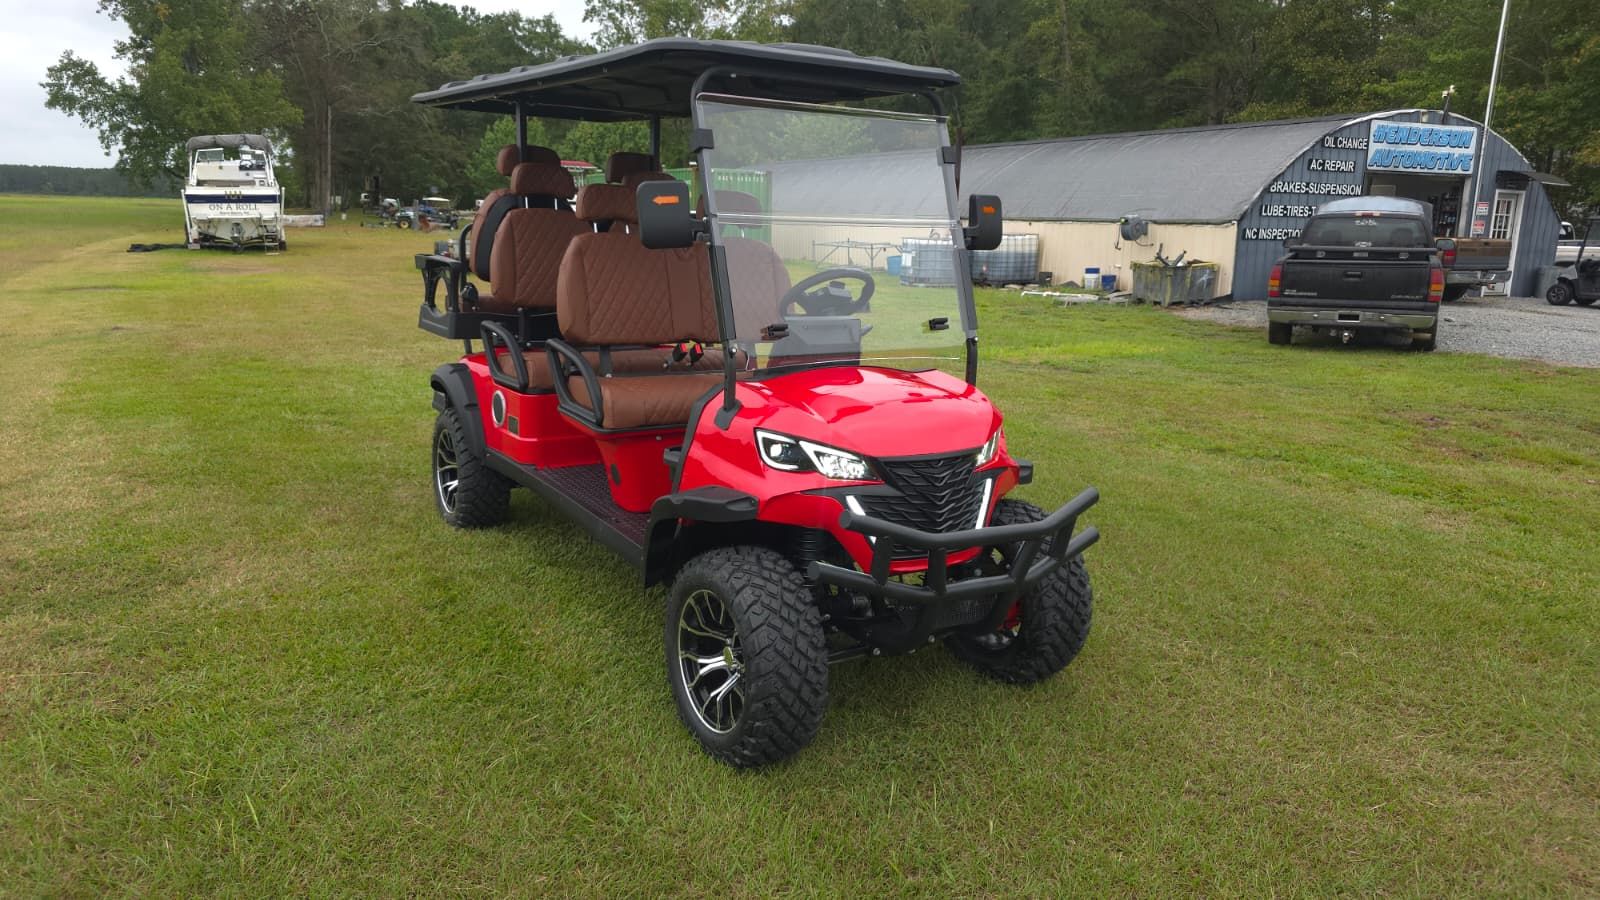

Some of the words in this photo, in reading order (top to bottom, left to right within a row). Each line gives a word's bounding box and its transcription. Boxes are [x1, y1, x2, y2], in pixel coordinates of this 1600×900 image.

[1324, 136, 1336, 148] OIL
[1337, 137, 1368, 150] CHANGE
[1373, 125, 1474, 148] HENDERSON
[1310, 159, 1323, 170] AC
[1324, 160, 1355, 172] REPAIR
[1368, 149, 1474, 172] AUTOMOTIVE
[208, 203, 223, 211] ON
[226, 203, 233, 211] A
[235, 203, 259, 211] ROLL
[1245, 228, 1257, 239] NC
[1259, 228, 1303, 240] INSPECTIO
